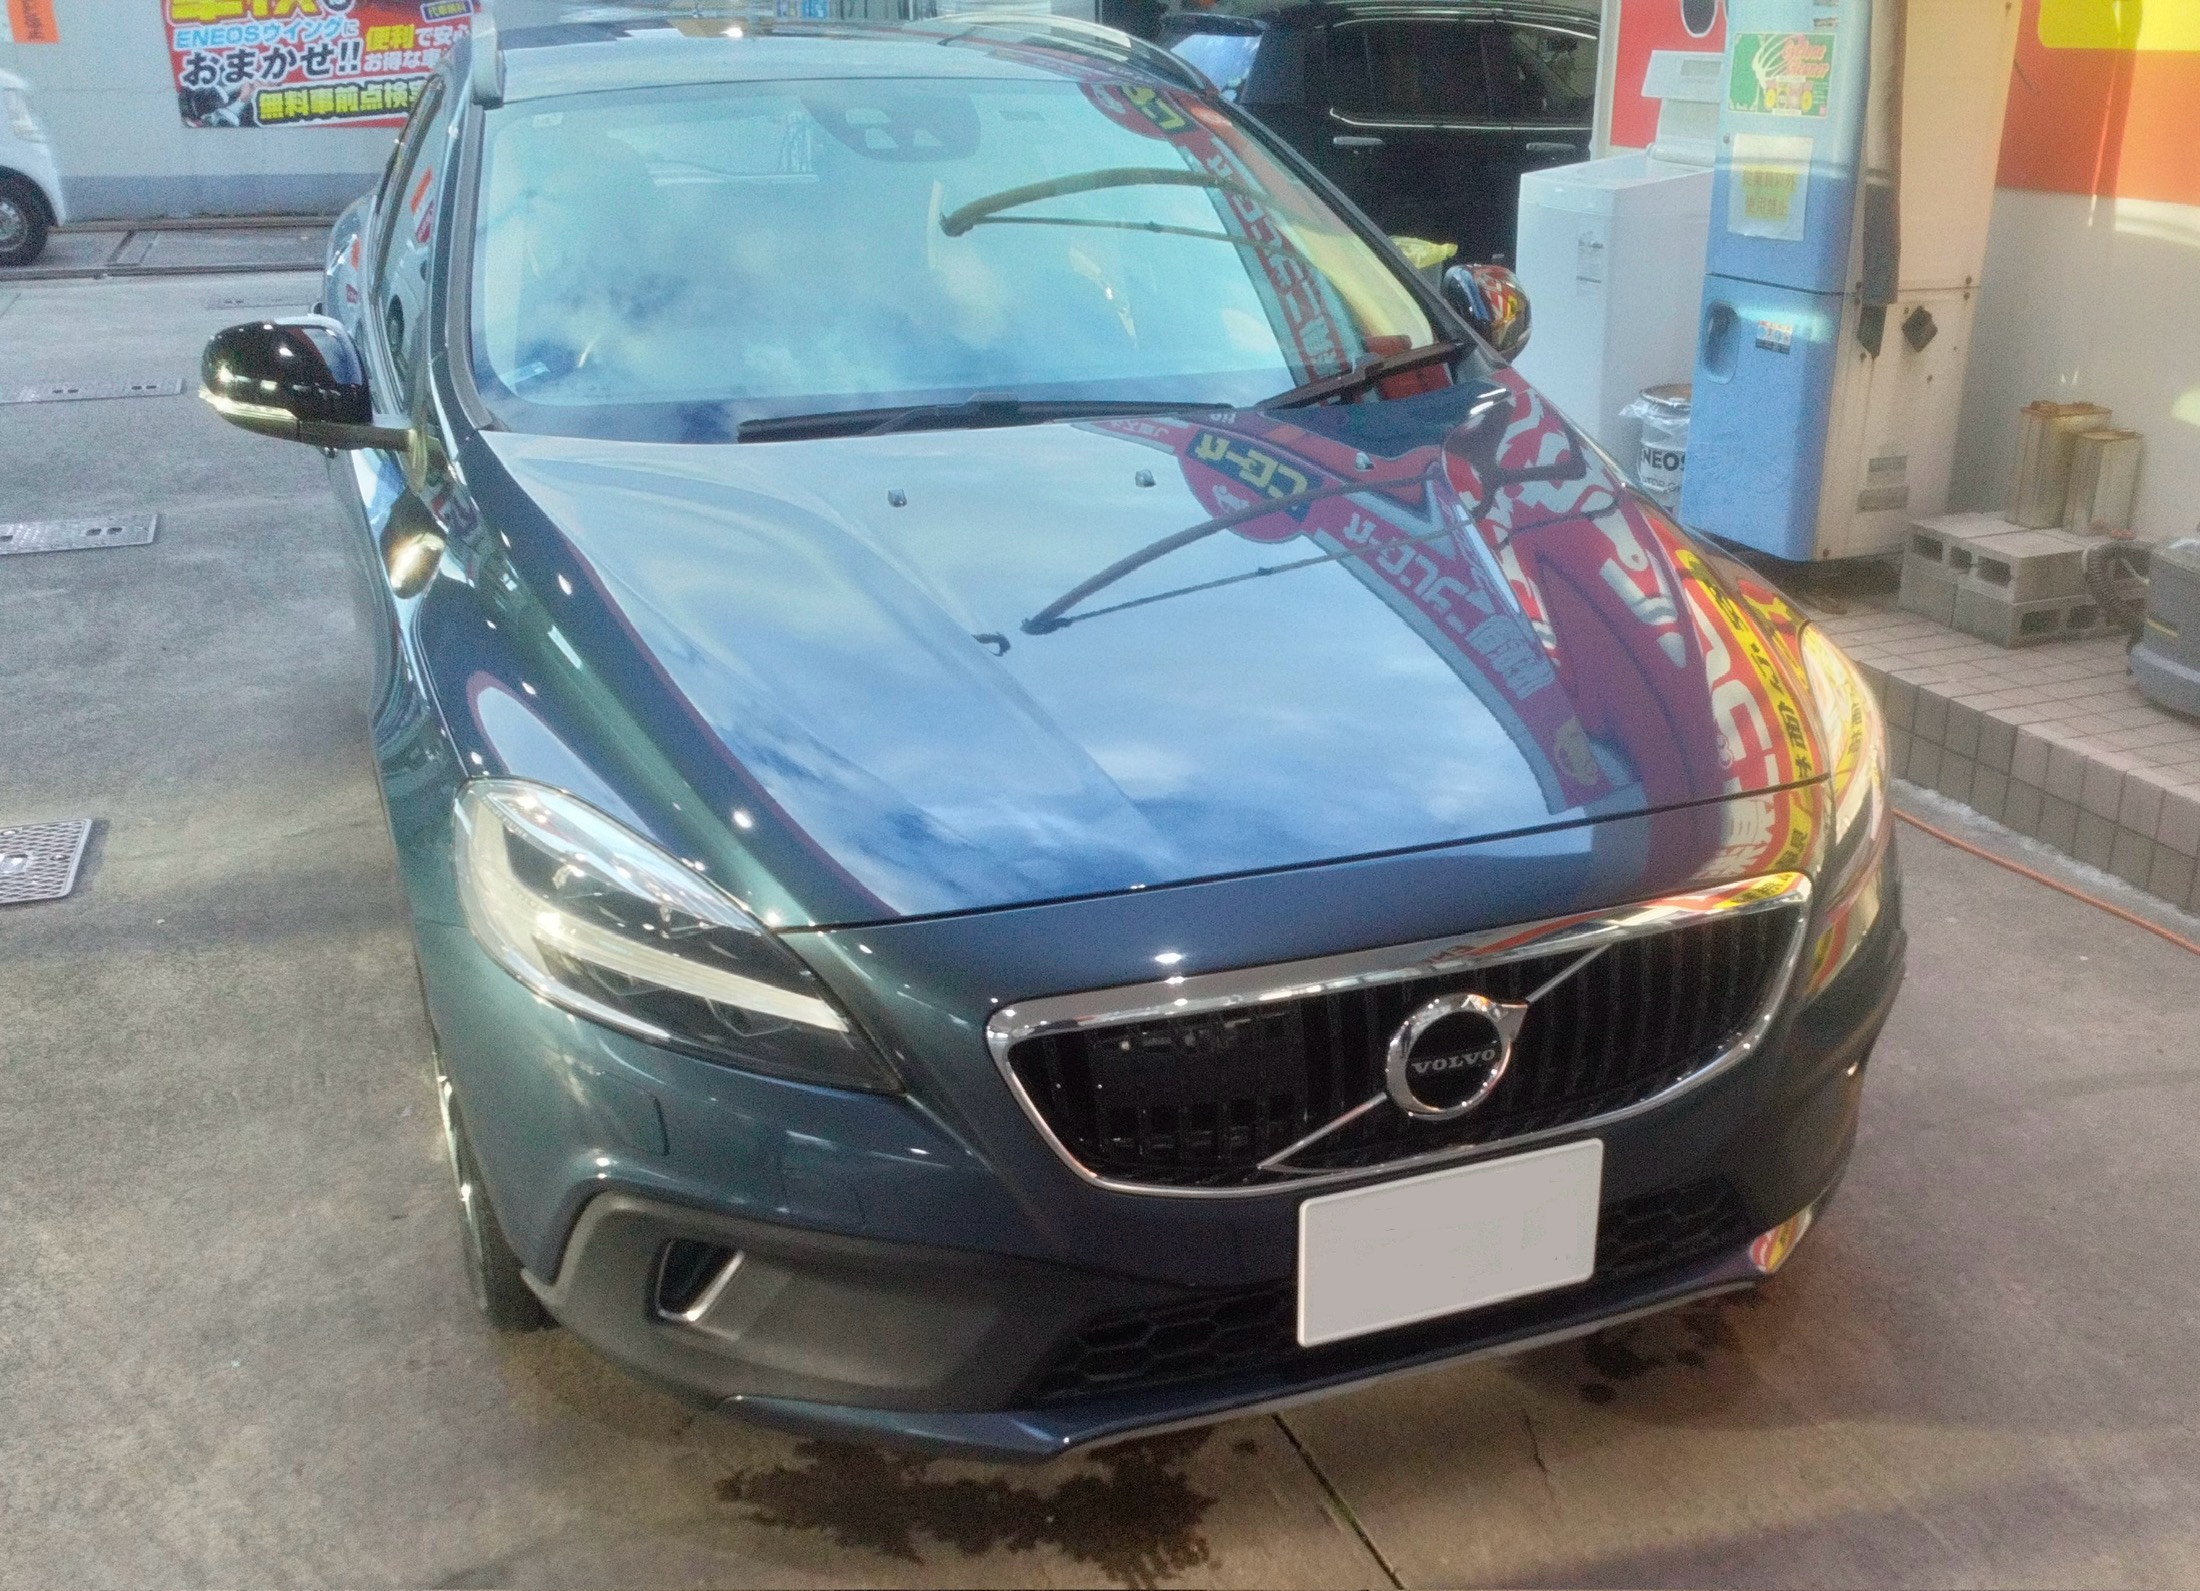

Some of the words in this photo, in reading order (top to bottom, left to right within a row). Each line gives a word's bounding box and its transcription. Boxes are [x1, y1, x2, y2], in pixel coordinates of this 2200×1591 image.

[182, 40, 362, 87] おまかせ!!
[1411, 1049, 1497, 1074] VOLVO
